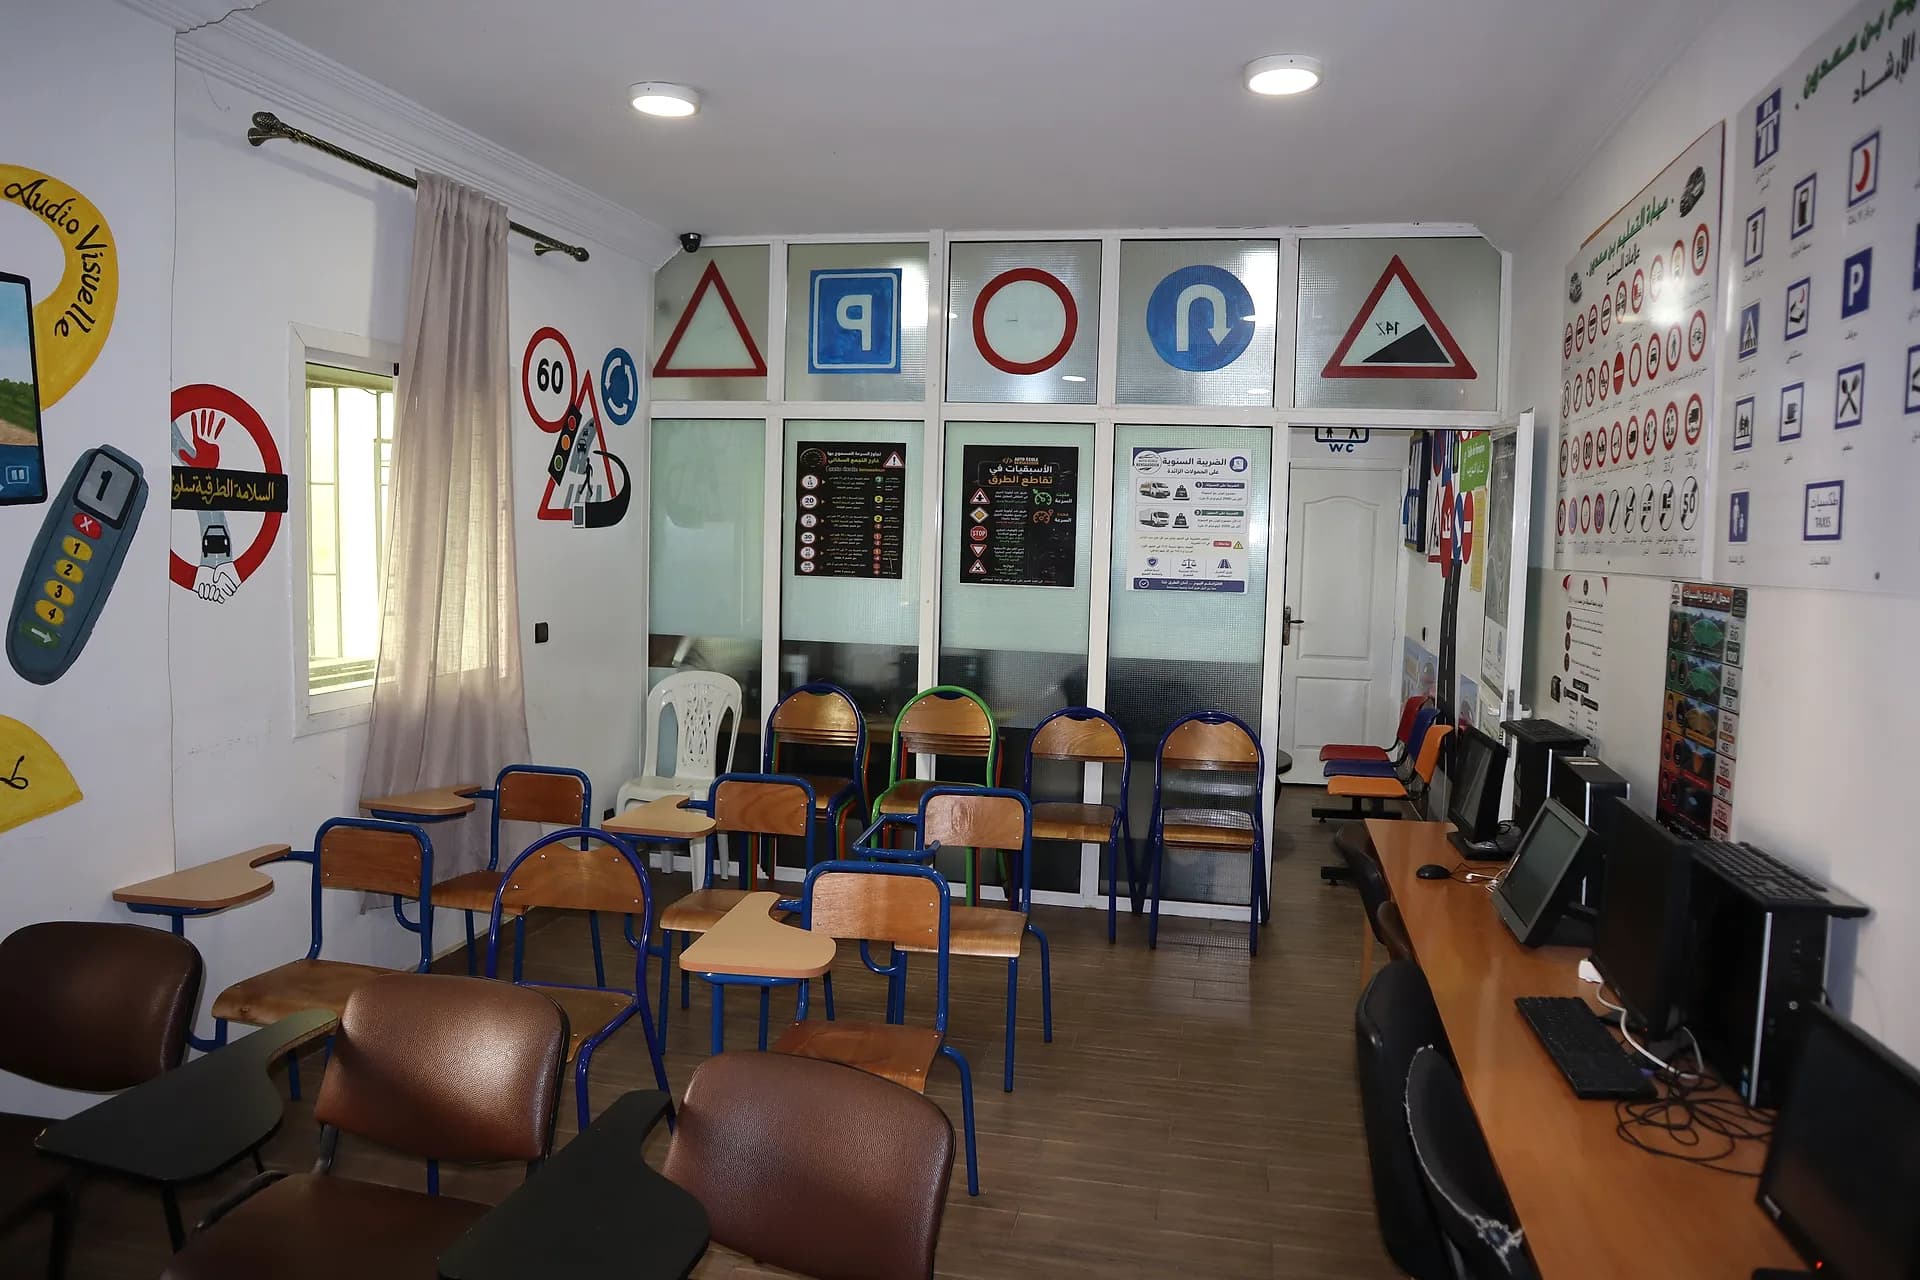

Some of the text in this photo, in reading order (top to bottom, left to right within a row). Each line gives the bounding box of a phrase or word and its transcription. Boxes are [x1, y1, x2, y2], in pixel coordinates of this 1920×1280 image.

[3, 178, 108, 337] Audio Visuelle
[1848, 263, 1864, 306] P
[537, 358, 564, 394] 60
[1328, 442, 1355, 453] WC
[1162, 457, 1227, 466] الضريبة السنوية
[989, 464, 1053, 475] الأسبقيات في
[95, 470, 113, 502] 1
[988, 475, 1053, 487] تقاطع الطرق
[193, 473, 234, 505] الطرقية
[234, 480, 275, 502] السلامة
[1683, 493, 1696, 514] 50
[73, 542, 81, 555] 1
[64, 564, 73, 576] 2
[54, 585, 63, 598] 3
[48, 607, 57, 619] 4
